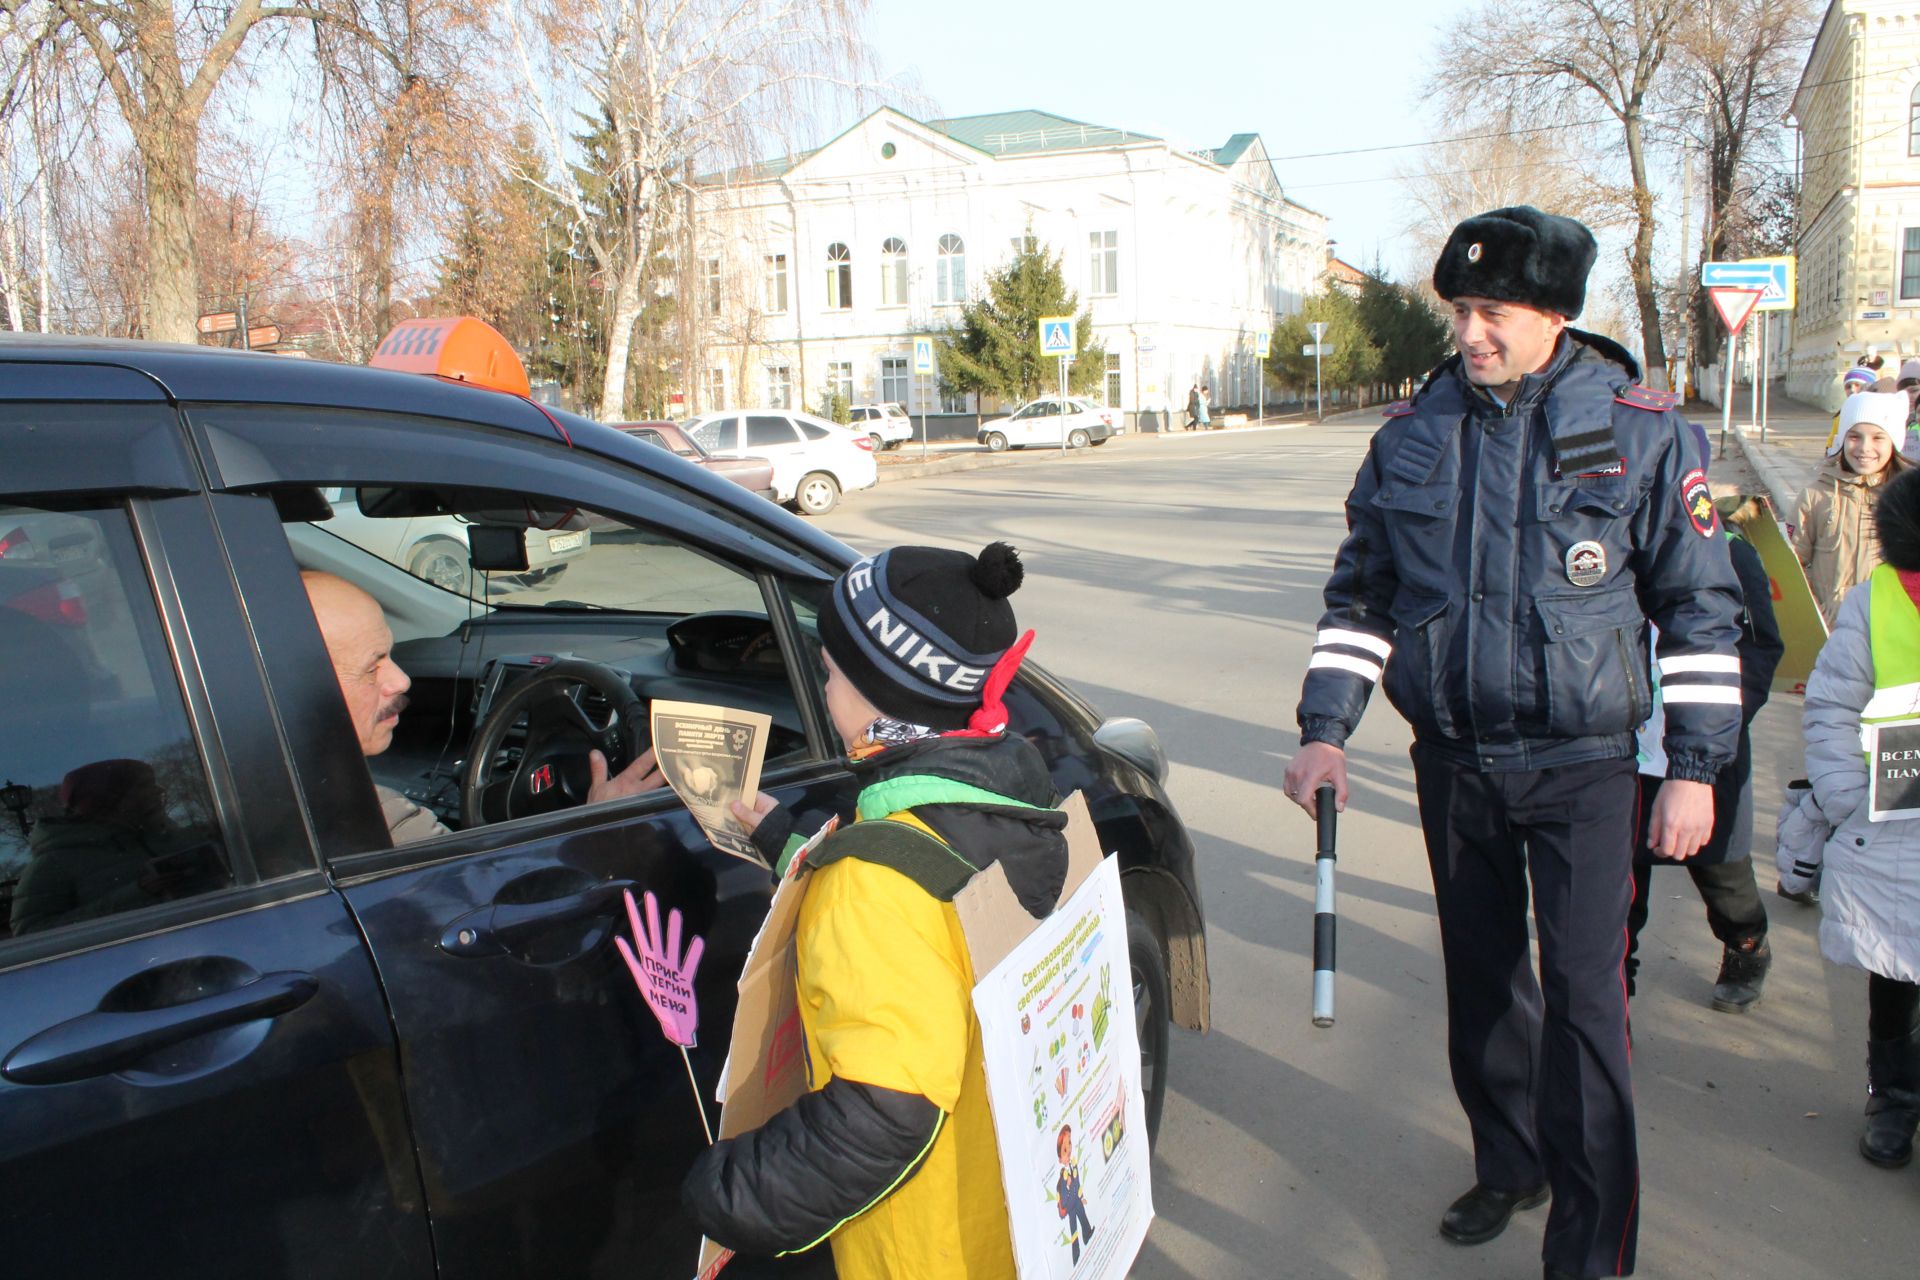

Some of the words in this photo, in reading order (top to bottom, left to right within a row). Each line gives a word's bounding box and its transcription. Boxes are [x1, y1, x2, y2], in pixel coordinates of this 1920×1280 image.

[866, 607, 985, 691] NIKE
[649, 989, 688, 1014] МЕНЯ
[650, 973, 691, 998] ТЕГНИ
[1017, 962, 1061, 1013] светящийся
[1061, 945, 1075, 970] друг
